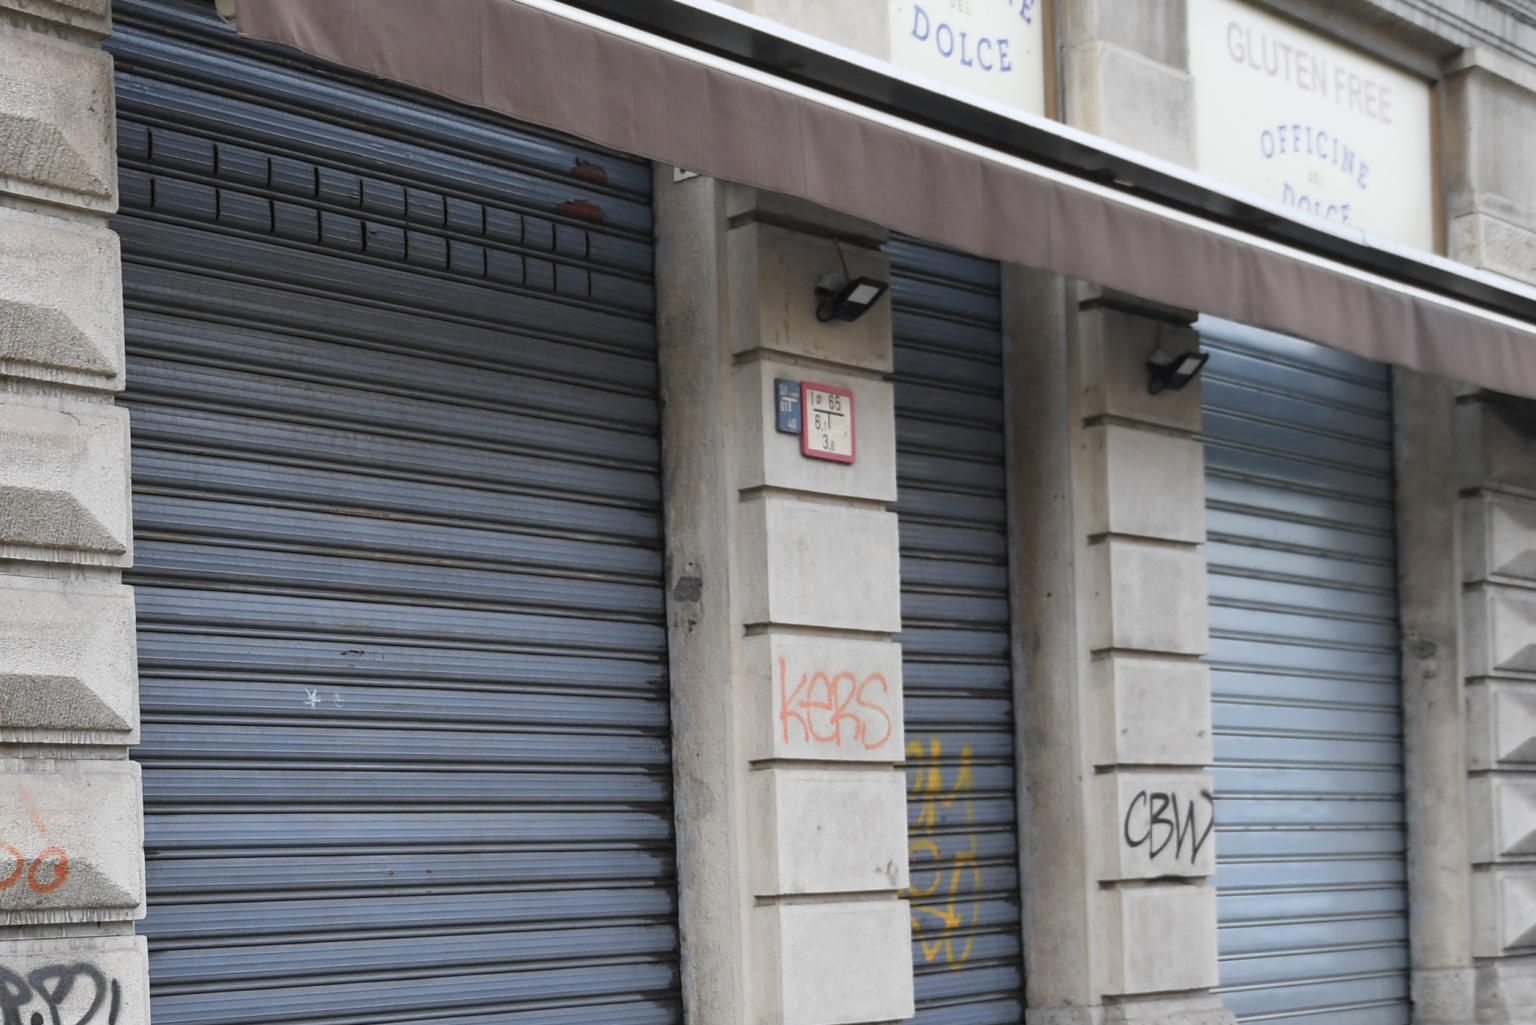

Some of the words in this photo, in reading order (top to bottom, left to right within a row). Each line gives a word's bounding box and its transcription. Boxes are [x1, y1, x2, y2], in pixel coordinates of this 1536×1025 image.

[911, 5, 1012, 72] DOLCE
[1226, 21, 1328, 98] GLUTEN
[1333, 66, 1393, 126] FREE
[1260, 124, 1370, 190] OFFICINE
[828, 392, 841, 411] 65
[1124, 789, 1215, 865] CBW
